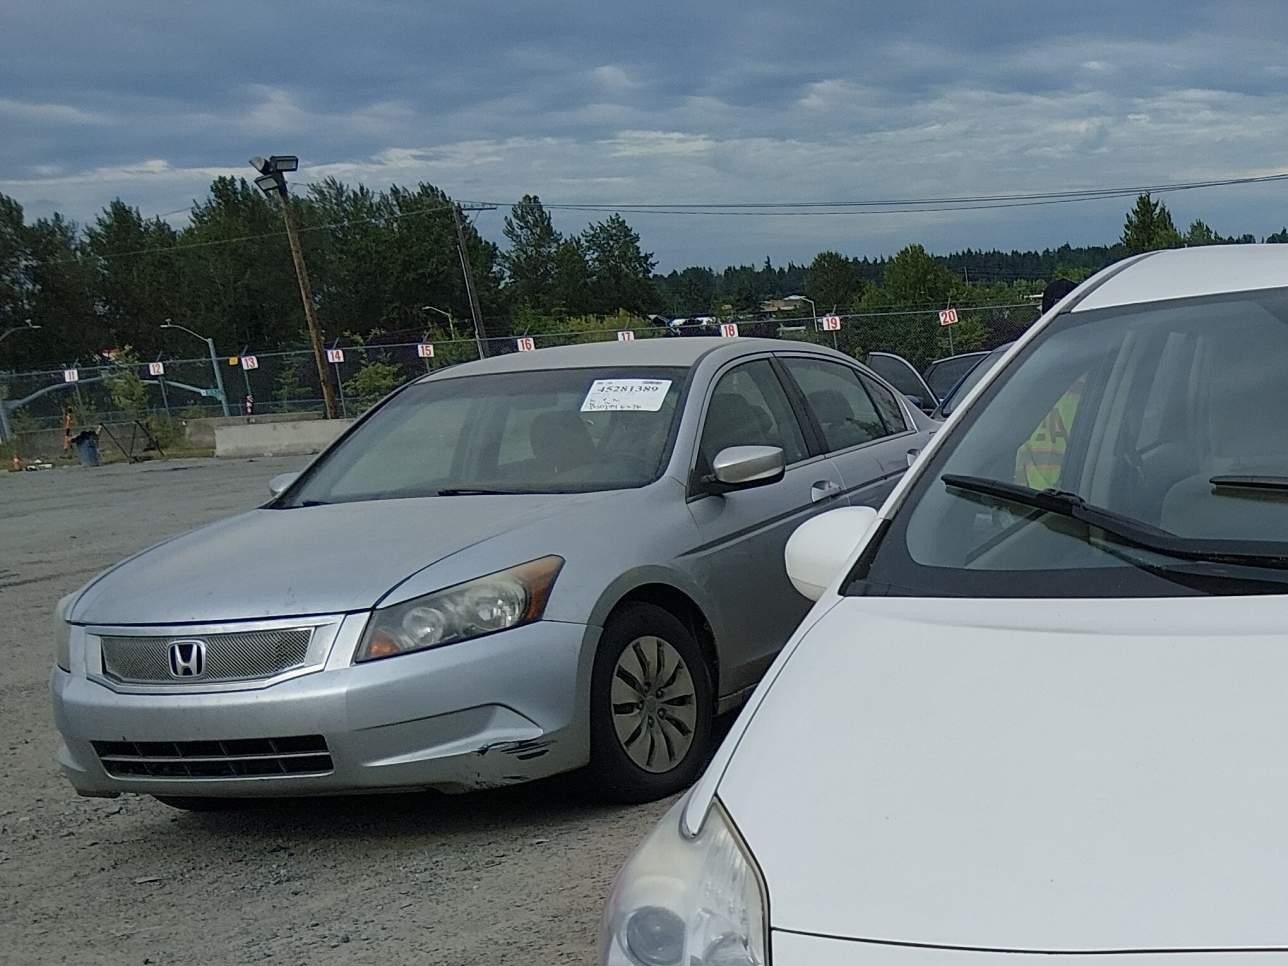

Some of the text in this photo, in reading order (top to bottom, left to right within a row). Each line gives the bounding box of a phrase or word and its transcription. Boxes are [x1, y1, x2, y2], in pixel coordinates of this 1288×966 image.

[941, 310, 956, 324] 20
[826, 318, 838, 329] 19
[723, 324, 735, 337] 18
[621, 332, 632, 341] 17
[520, 338, 532, 350] 16
[421, 345, 432, 355] 15
[330, 351, 341, 361] 14
[244, 357, 255, 368] 13
[151, 363, 161, 374] 12
[597, 385, 660, 394] 45281389
